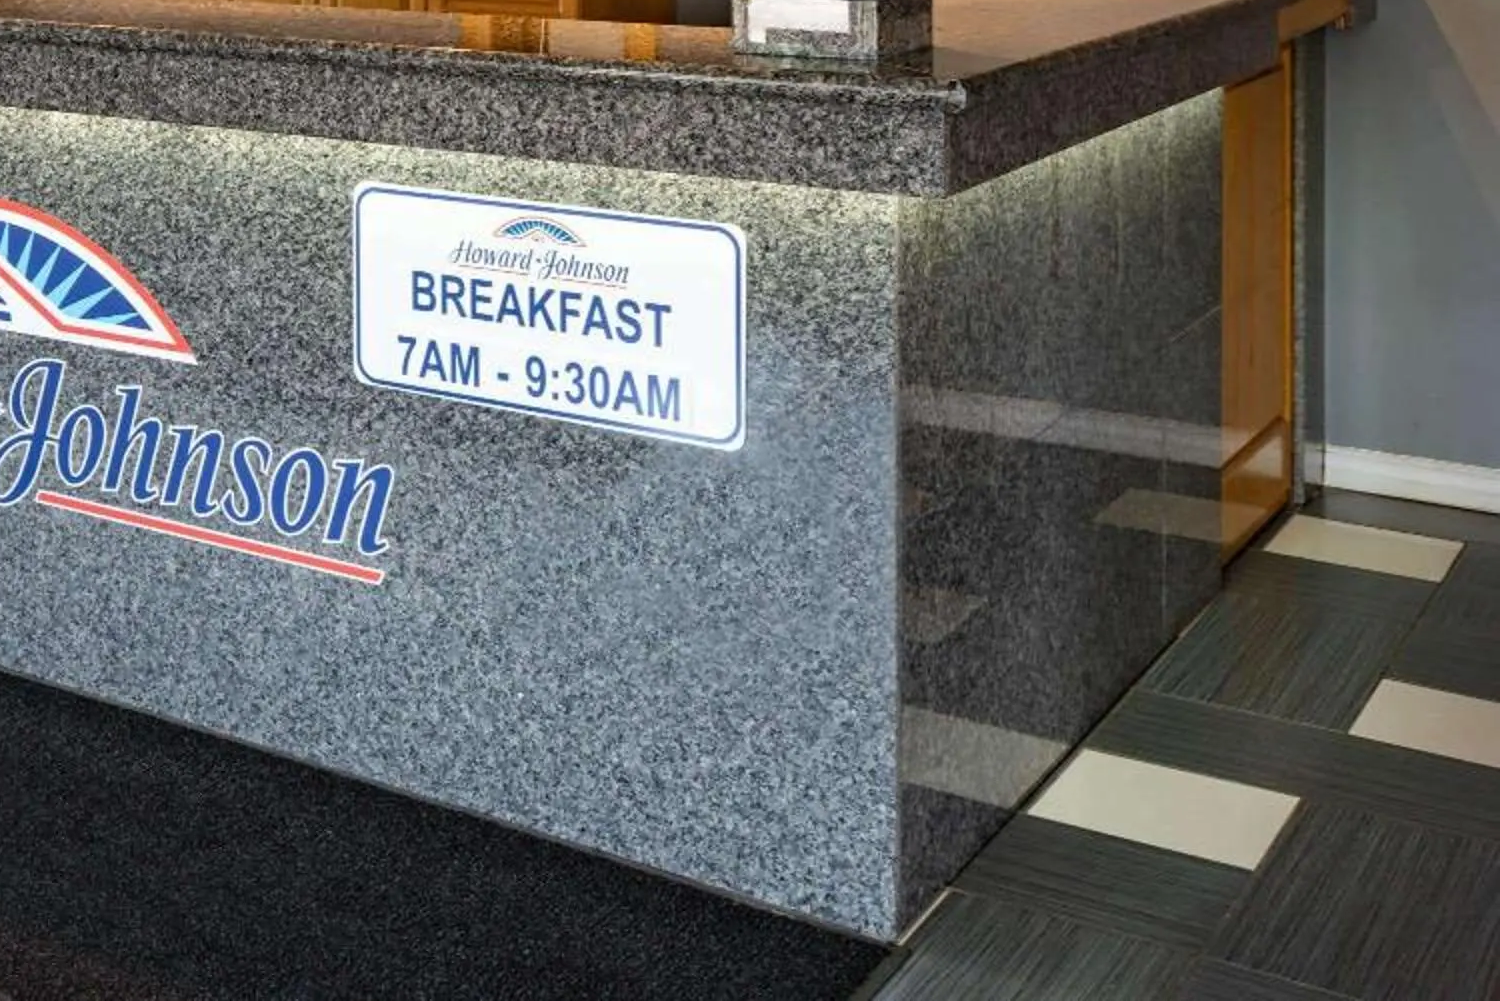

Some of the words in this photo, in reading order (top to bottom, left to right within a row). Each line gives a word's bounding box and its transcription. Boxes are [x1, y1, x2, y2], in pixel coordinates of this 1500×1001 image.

[450, 239, 533, 271] Howard
[537, 249, 630, 284] Johnson
[411, 270, 672, 348] BREAKFAST
[397, 334, 481, 388] 7AM
[525, 355, 680, 422] 9:30AM
